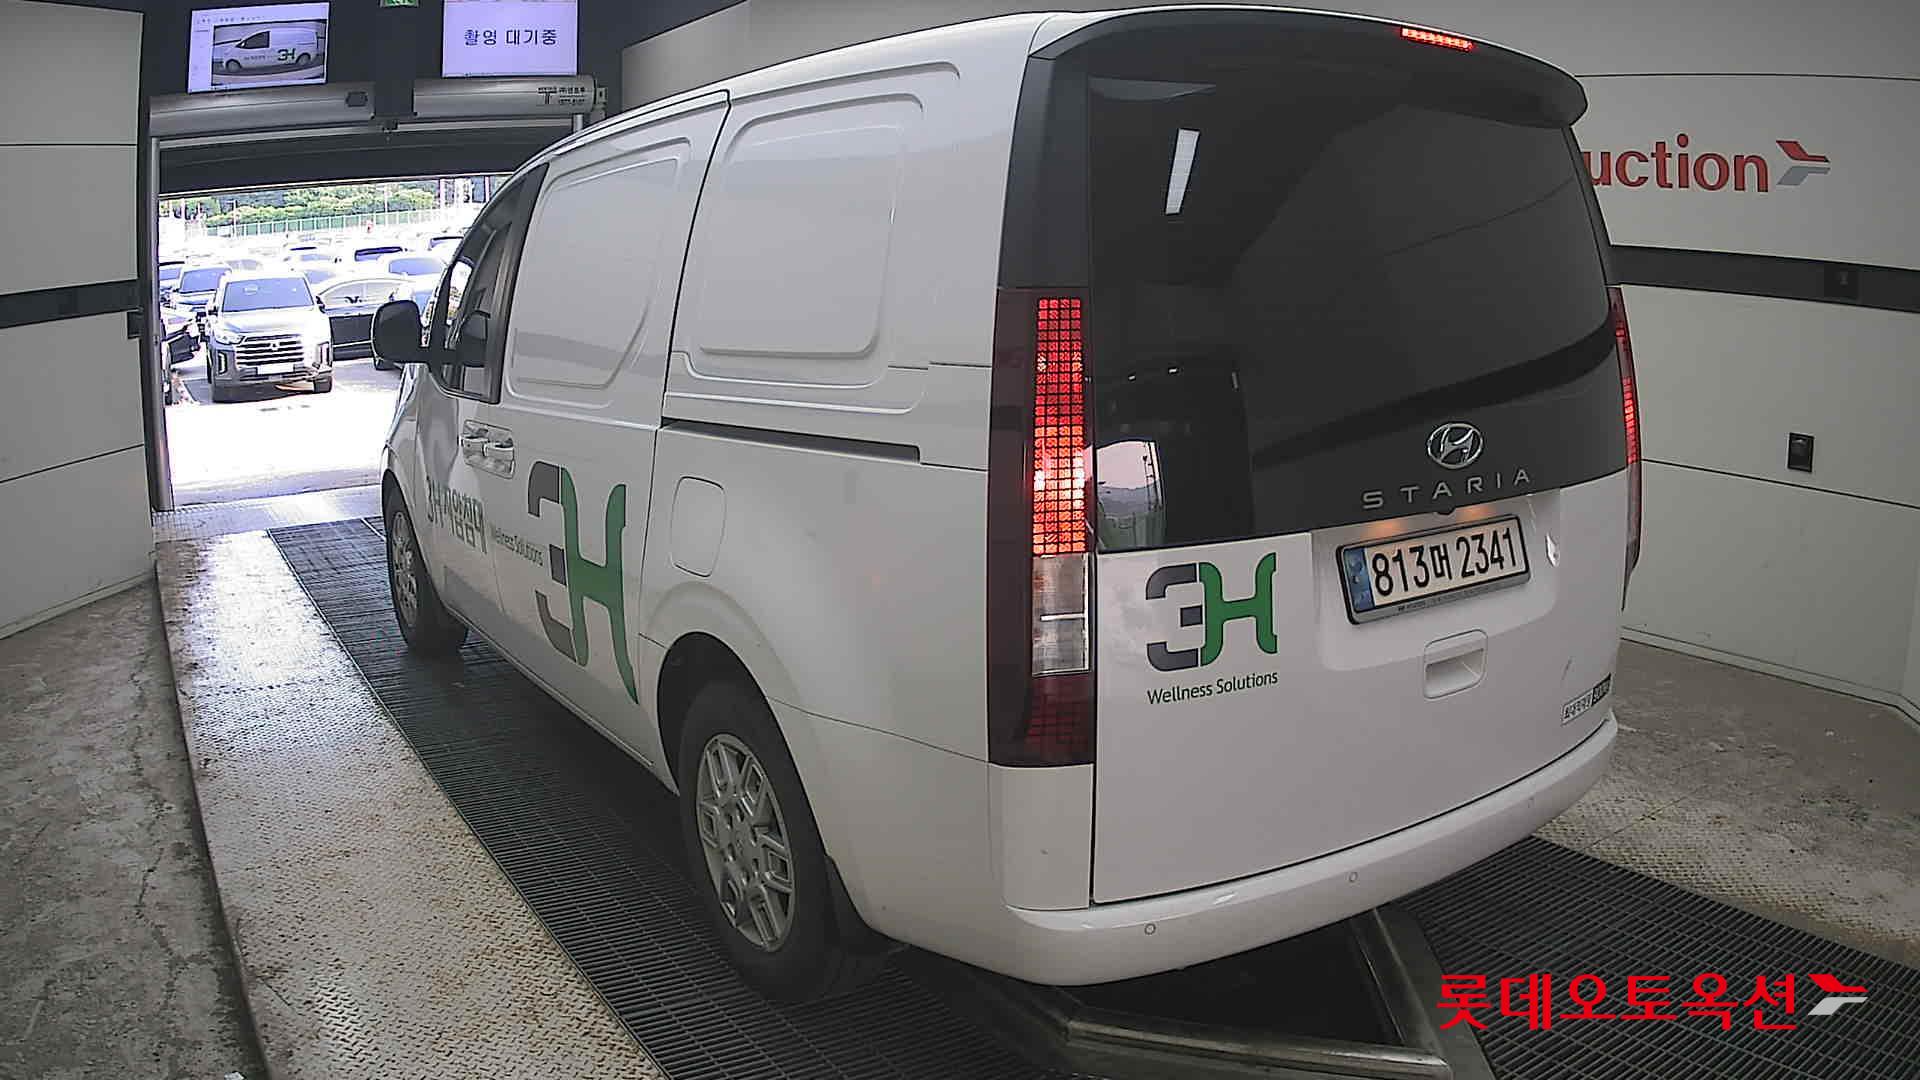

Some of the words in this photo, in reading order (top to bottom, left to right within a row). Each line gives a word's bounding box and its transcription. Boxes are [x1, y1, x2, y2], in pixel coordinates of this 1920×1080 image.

[464, 29, 497, 46] 촬영
[505, 29, 557, 46] 대기중
[1362, 468, 1530, 509] STARIA
[1455, 527, 1517, 579] 2341
[1145, 552, 1278, 672] 3H
[1146, 685, 1213, 705] Wellness
[1215, 671, 1278, 695] Solutions
